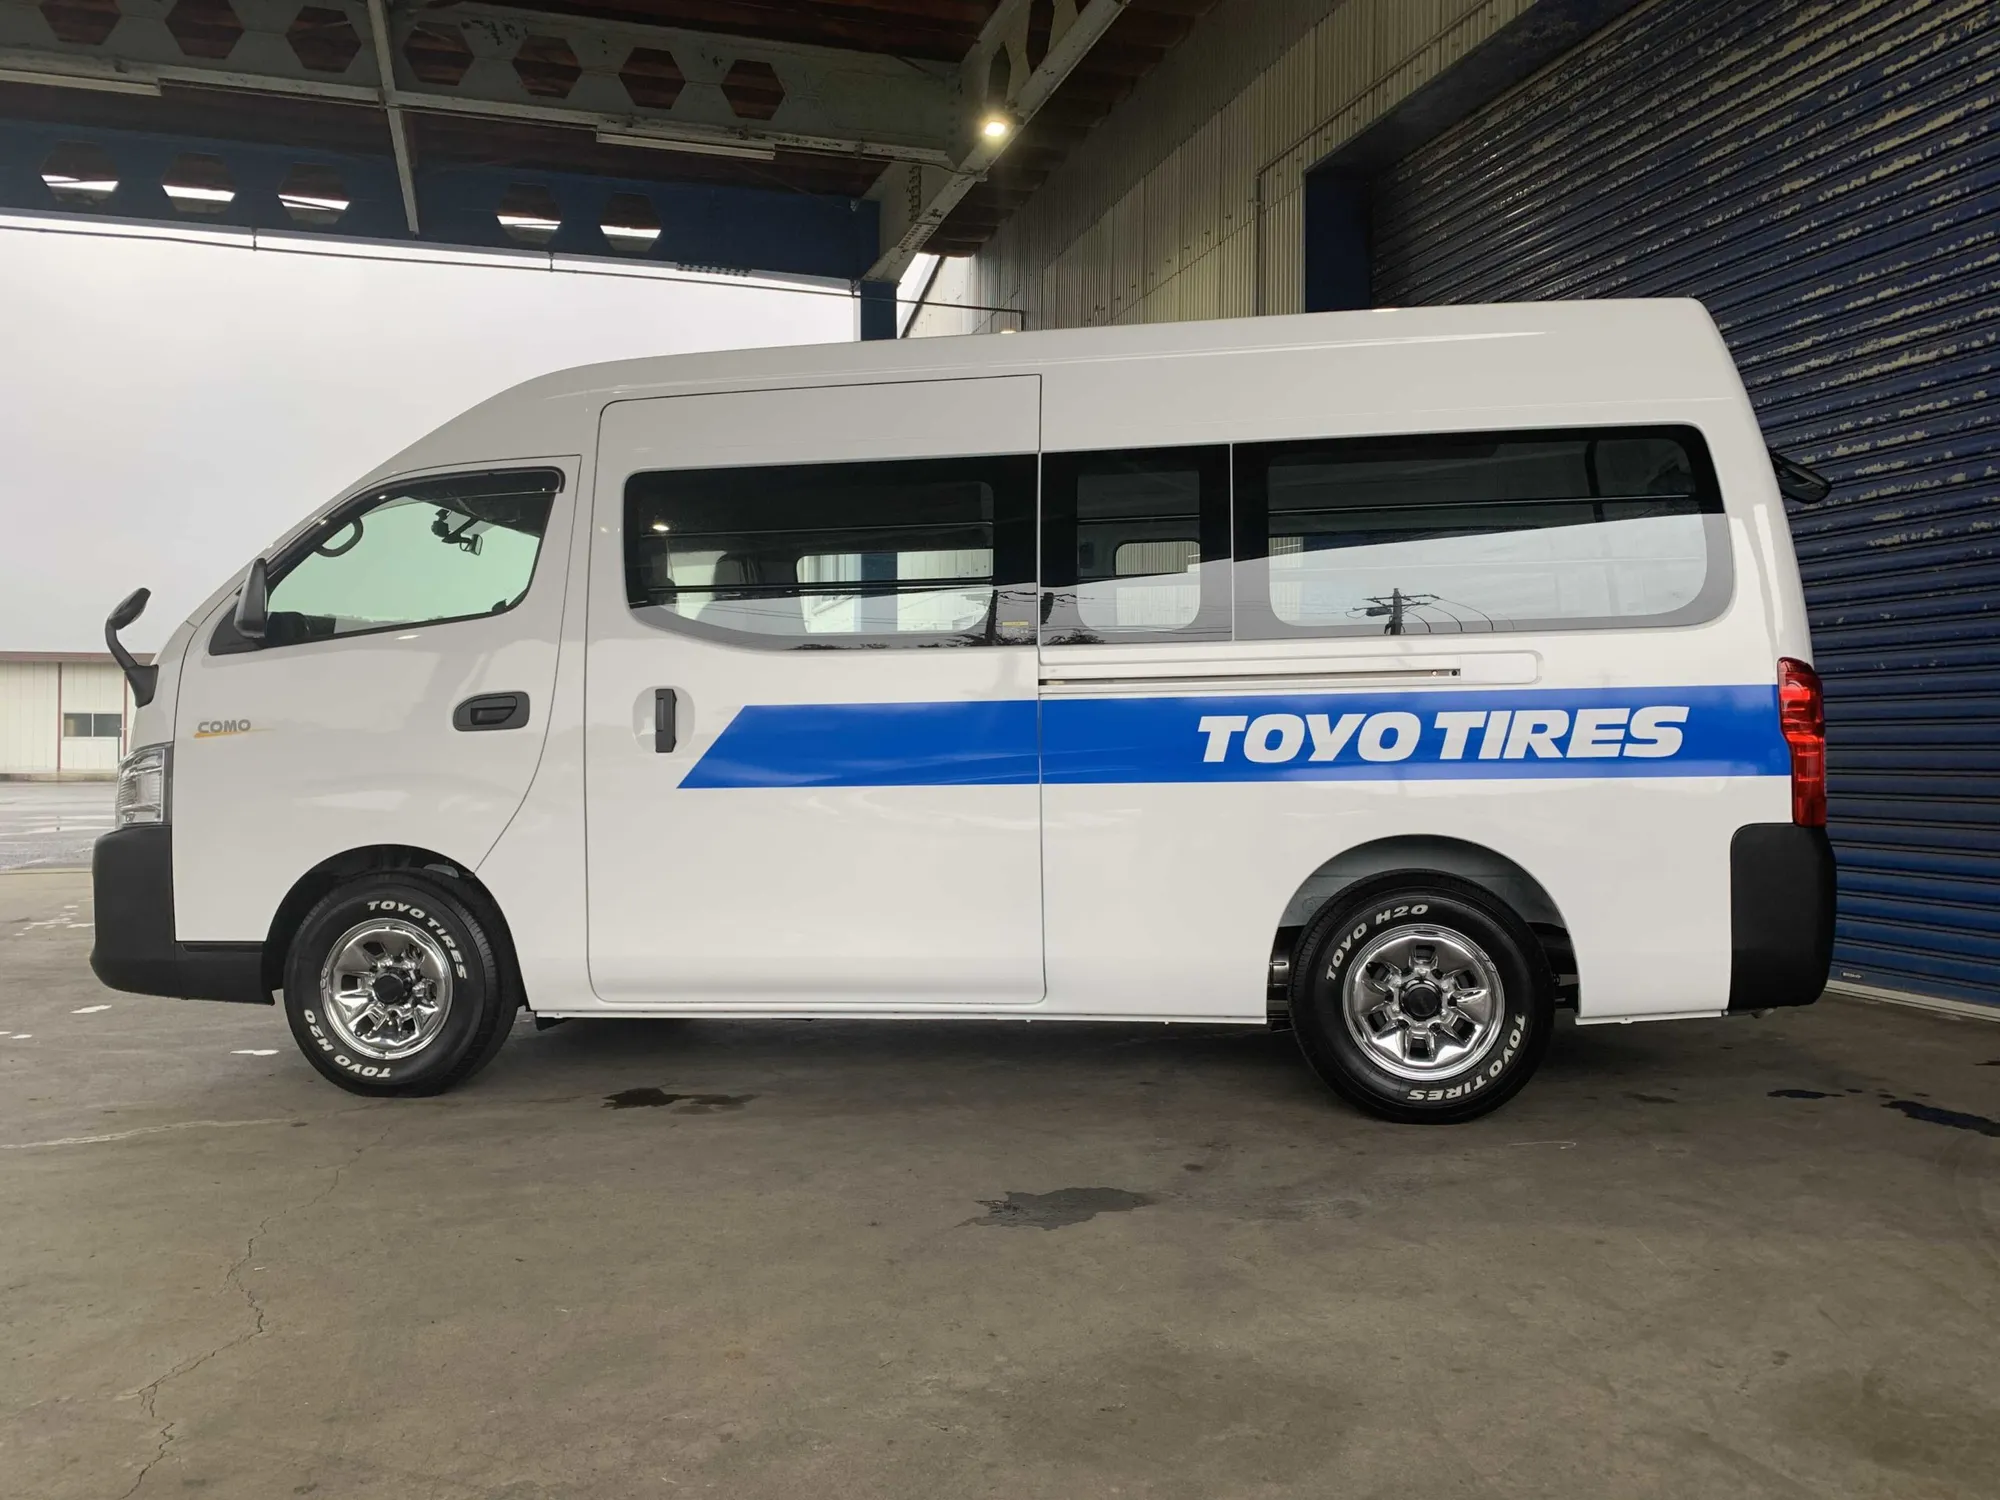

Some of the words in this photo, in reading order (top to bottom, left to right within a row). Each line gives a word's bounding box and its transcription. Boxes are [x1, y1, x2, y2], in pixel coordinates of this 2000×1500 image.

[197, 719, 251, 733] COMO
[1198, 711, 1421, 763] TOYO
[1434, 706, 1690, 760] TIRES
[367, 900, 426, 919] TOYO
[427, 917, 468, 980] TIRES
[1326, 922, 1368, 981] TOYO
[334, 1054, 391, 1078] TOYO
[1489, 1014, 1526, 1078] TOYO
[1407, 1075, 1488, 1101] TIRES
